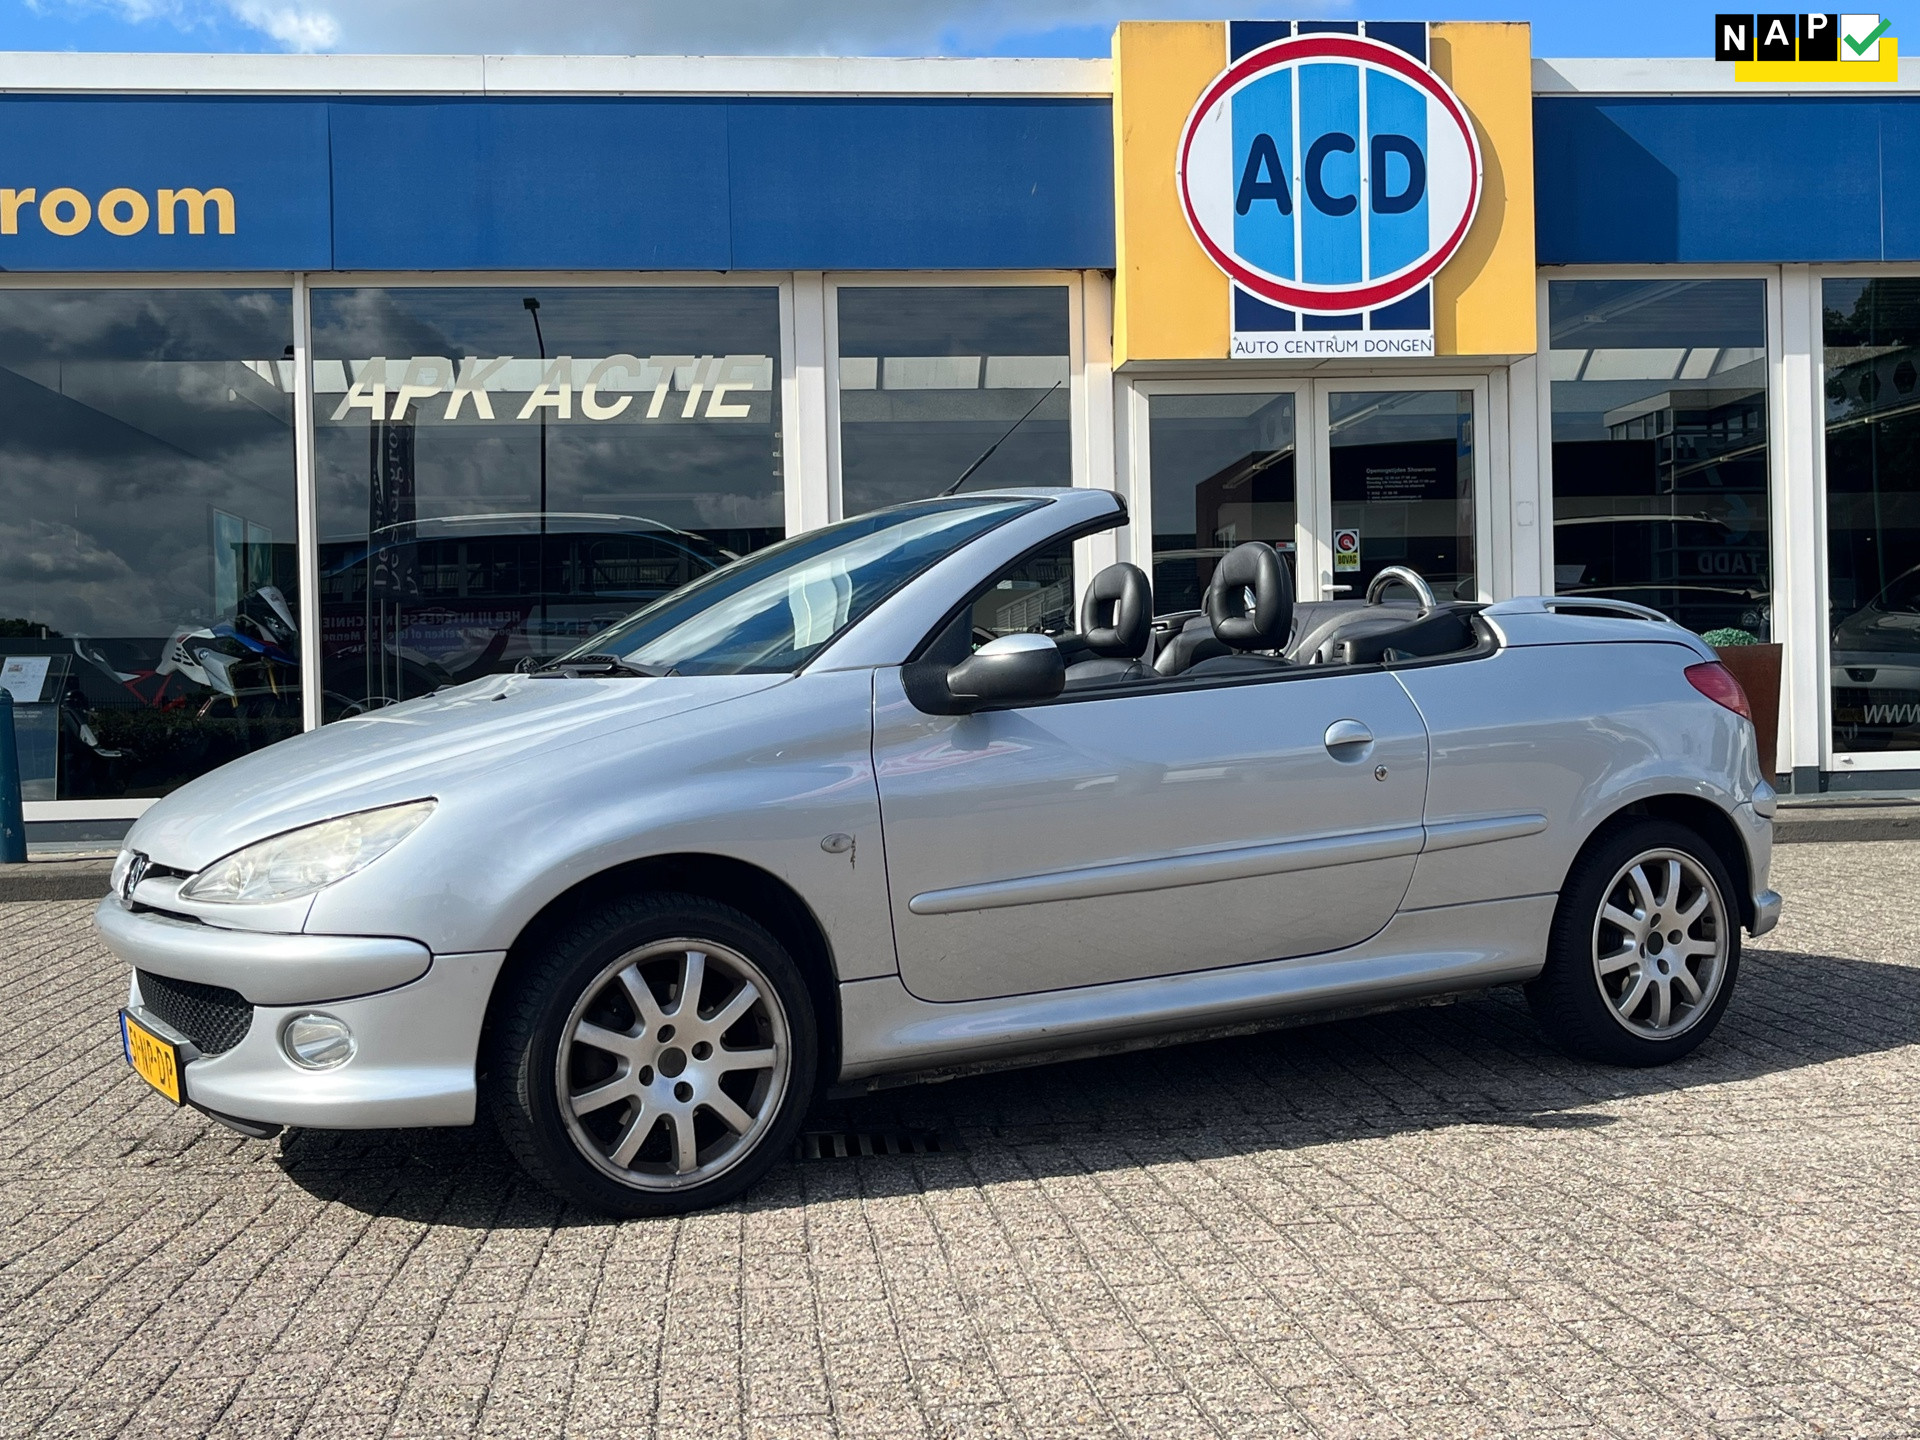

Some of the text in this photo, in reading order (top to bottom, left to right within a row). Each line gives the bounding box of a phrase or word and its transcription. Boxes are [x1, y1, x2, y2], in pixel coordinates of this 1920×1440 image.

[1236, 132, 1426, 216] ACD
[0, 187, 236, 236] room
[1235, 339, 1432, 354] AUTO CENTRUM DONGEN
[330, 353, 767, 420] APK ACTIE
[1337, 554, 1357, 565] BOVAG
